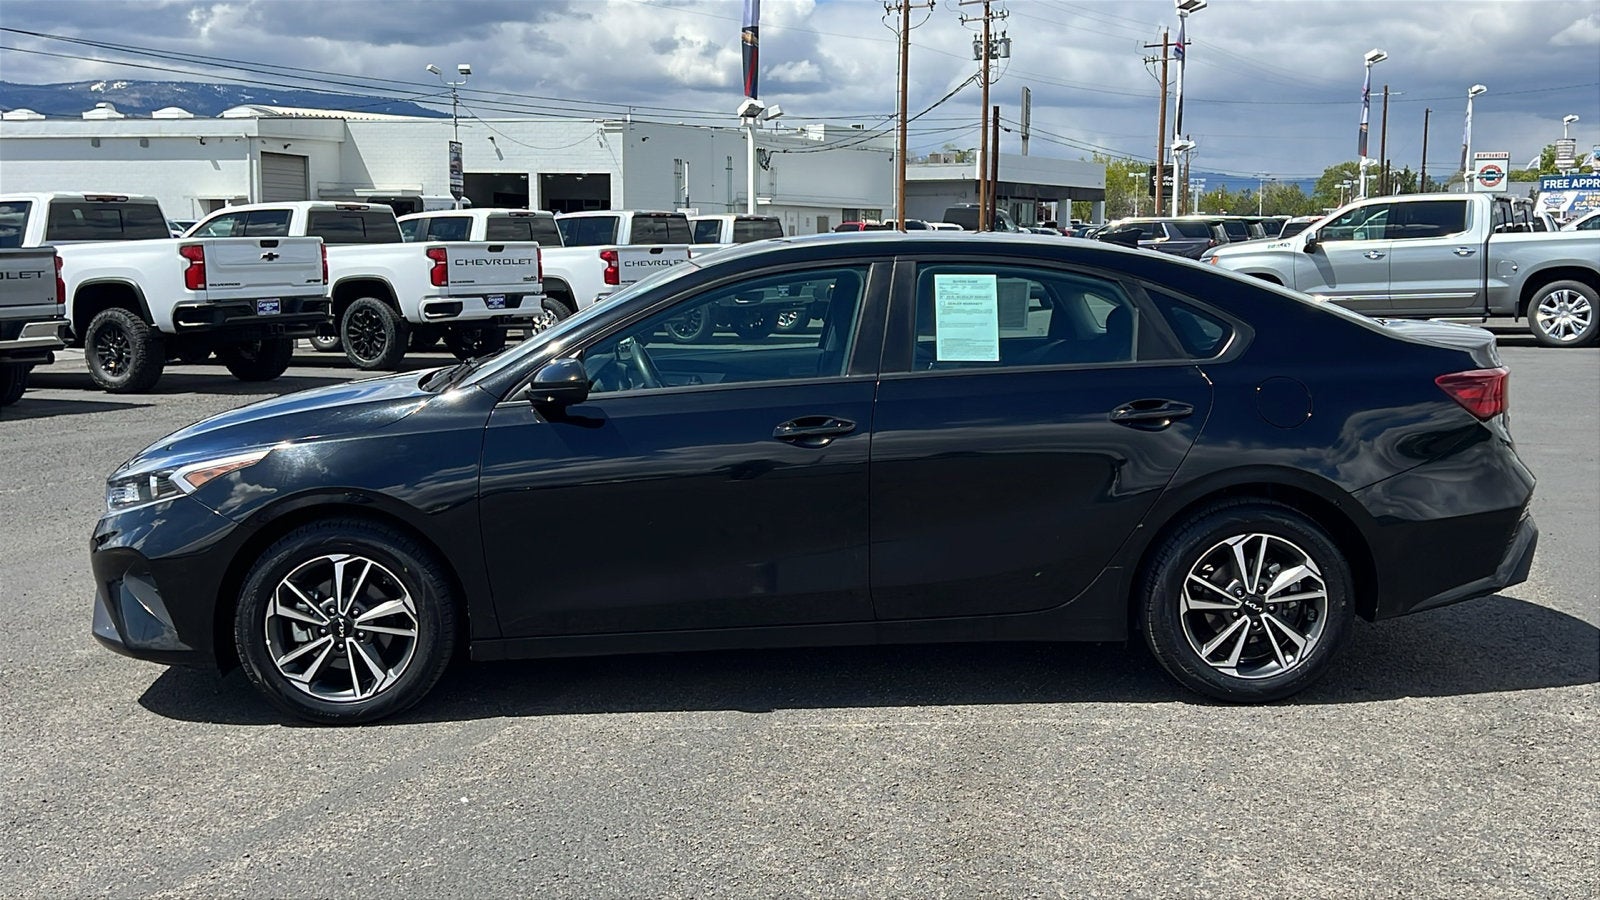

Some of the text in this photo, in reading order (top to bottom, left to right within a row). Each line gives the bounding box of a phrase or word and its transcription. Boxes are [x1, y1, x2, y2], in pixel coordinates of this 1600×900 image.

[1543, 178, 1600, 189] FREE APPR
[455, 258, 533, 266] CHEVROLET
[0, 270, 45, 280] LET
